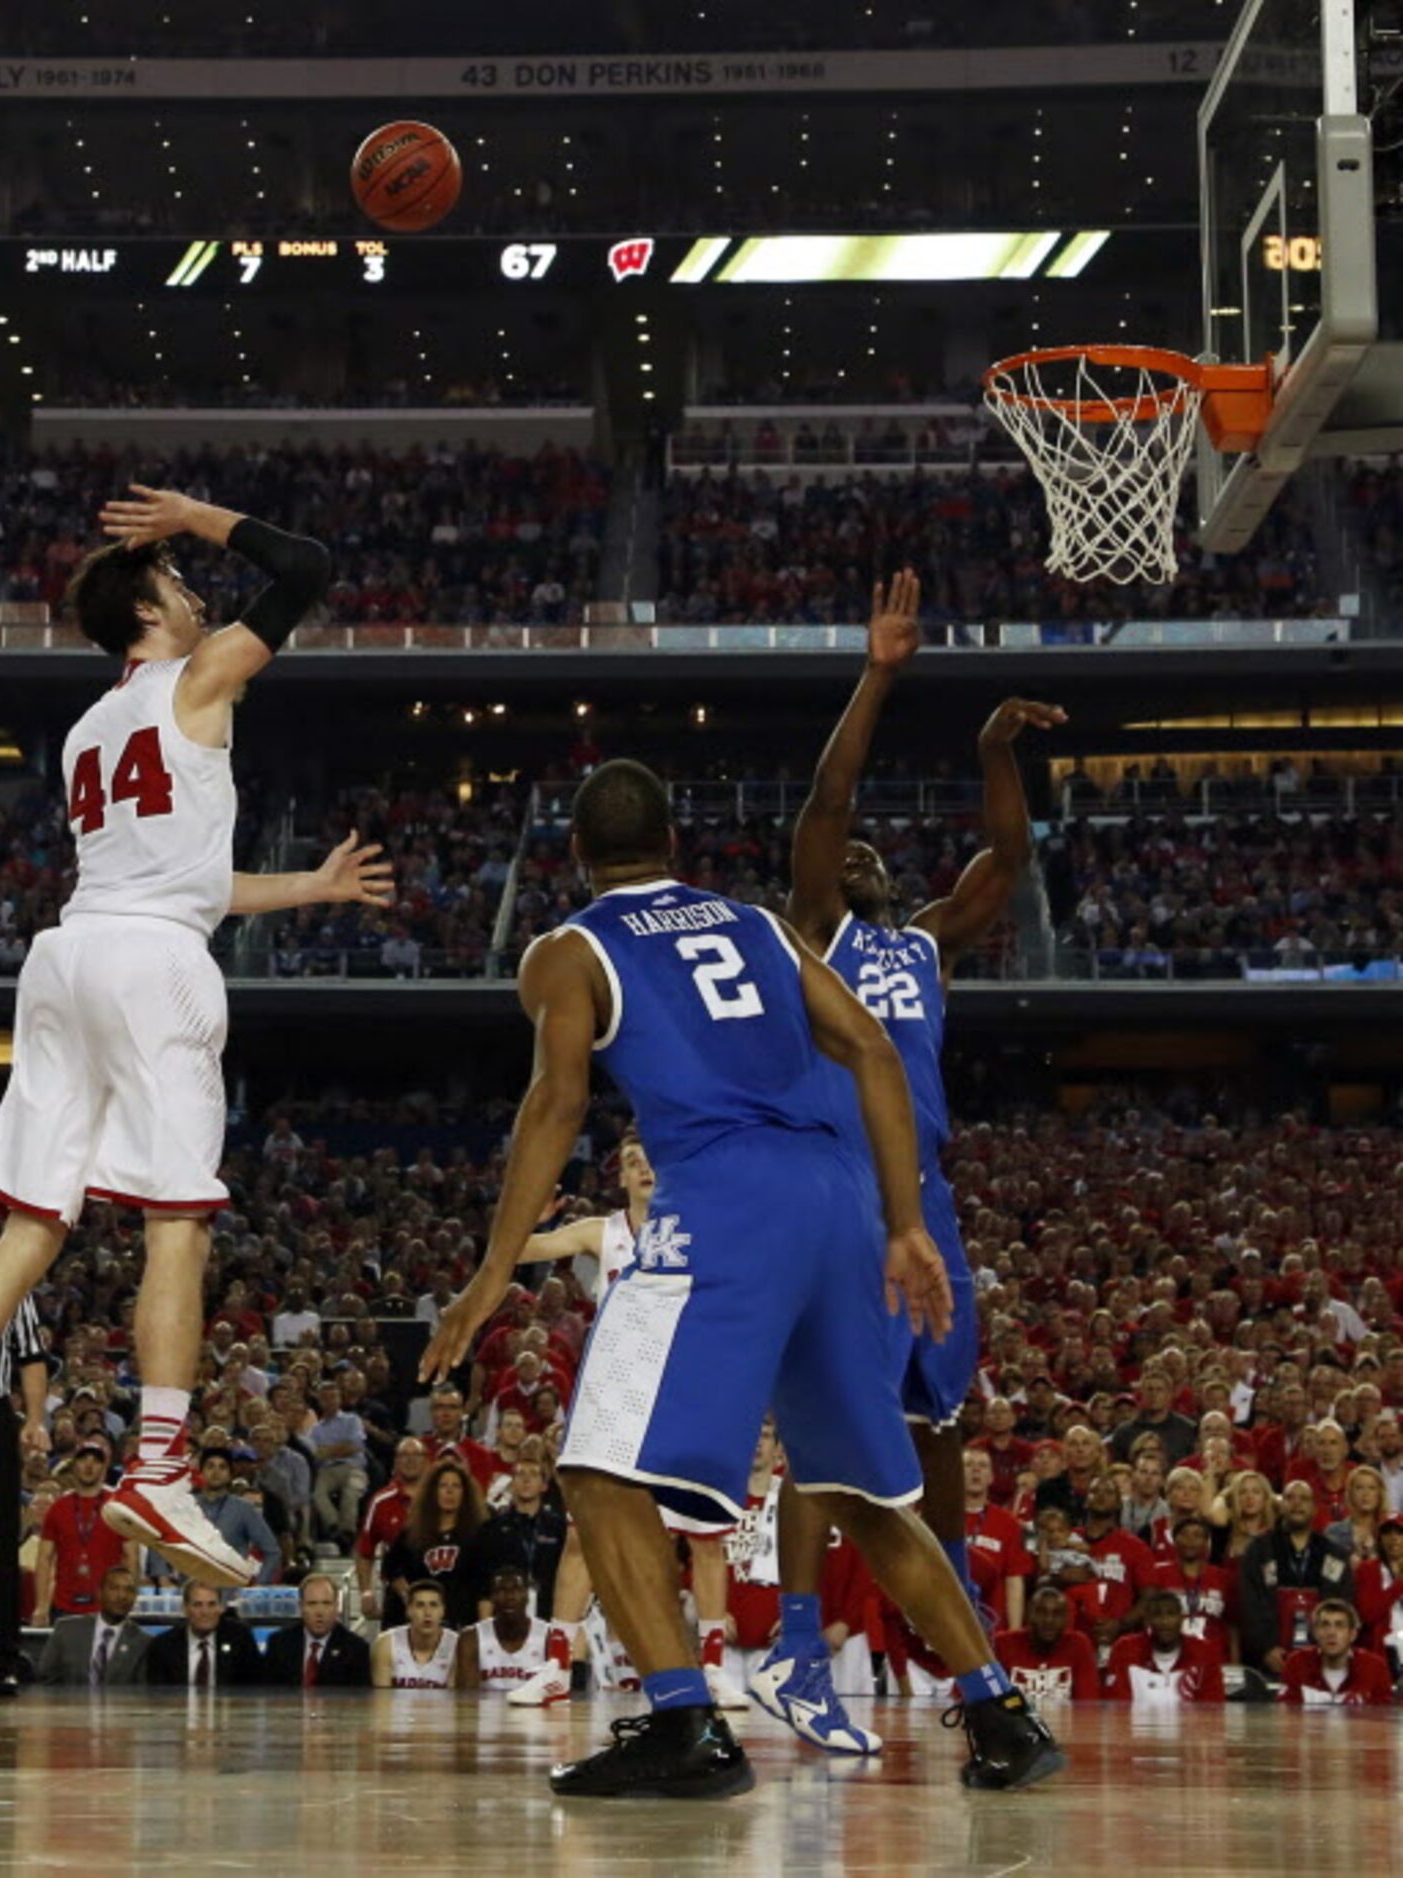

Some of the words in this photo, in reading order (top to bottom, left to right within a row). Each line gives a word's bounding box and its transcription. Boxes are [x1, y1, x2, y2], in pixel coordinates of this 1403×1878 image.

[461, 65, 496, 87] 43
[515, 64, 577, 87] DON
[588, 62, 713, 86] PERKINS
[1169, 50, 1198, 73] 12
[36, 69, 136, 86] 1961-1974
[26, 250, 59, 272] 2ND
[61, 249, 118, 272] HALF
[279, 242, 338, 256] BONUS
[356, 242, 389, 256] TOL
[500, 244, 557, 279] 67
[239, 257, 263, 283] 7
[364, 256, 385, 282] 3
[70, 725, 174, 837] 44
[620, 899, 740, 937] HARRISON
[674, 934, 766, 1021] 2
[857, 963, 925, 1019] 22
